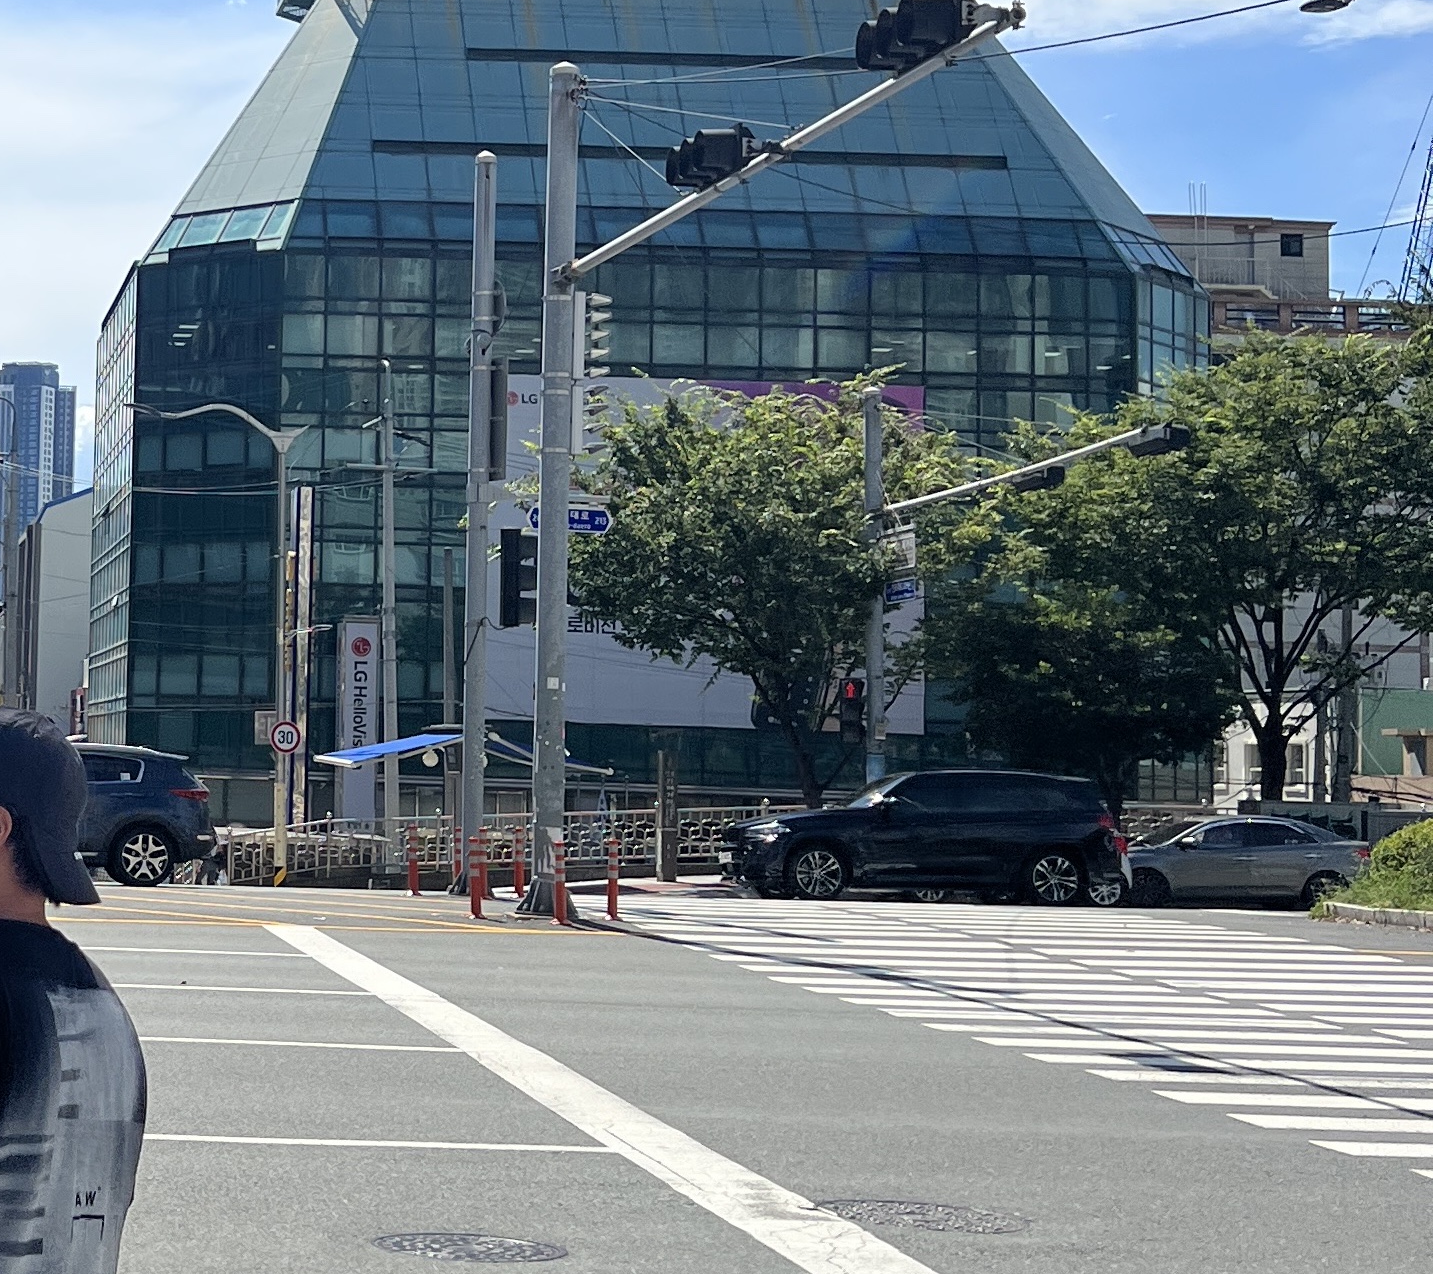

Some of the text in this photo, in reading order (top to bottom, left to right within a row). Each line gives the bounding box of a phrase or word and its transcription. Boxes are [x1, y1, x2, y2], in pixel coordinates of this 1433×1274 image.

[521, 393, 538, 404] LG
[352, 660, 368, 749] LG HelloVis
[277, 729, 294, 745] 30
